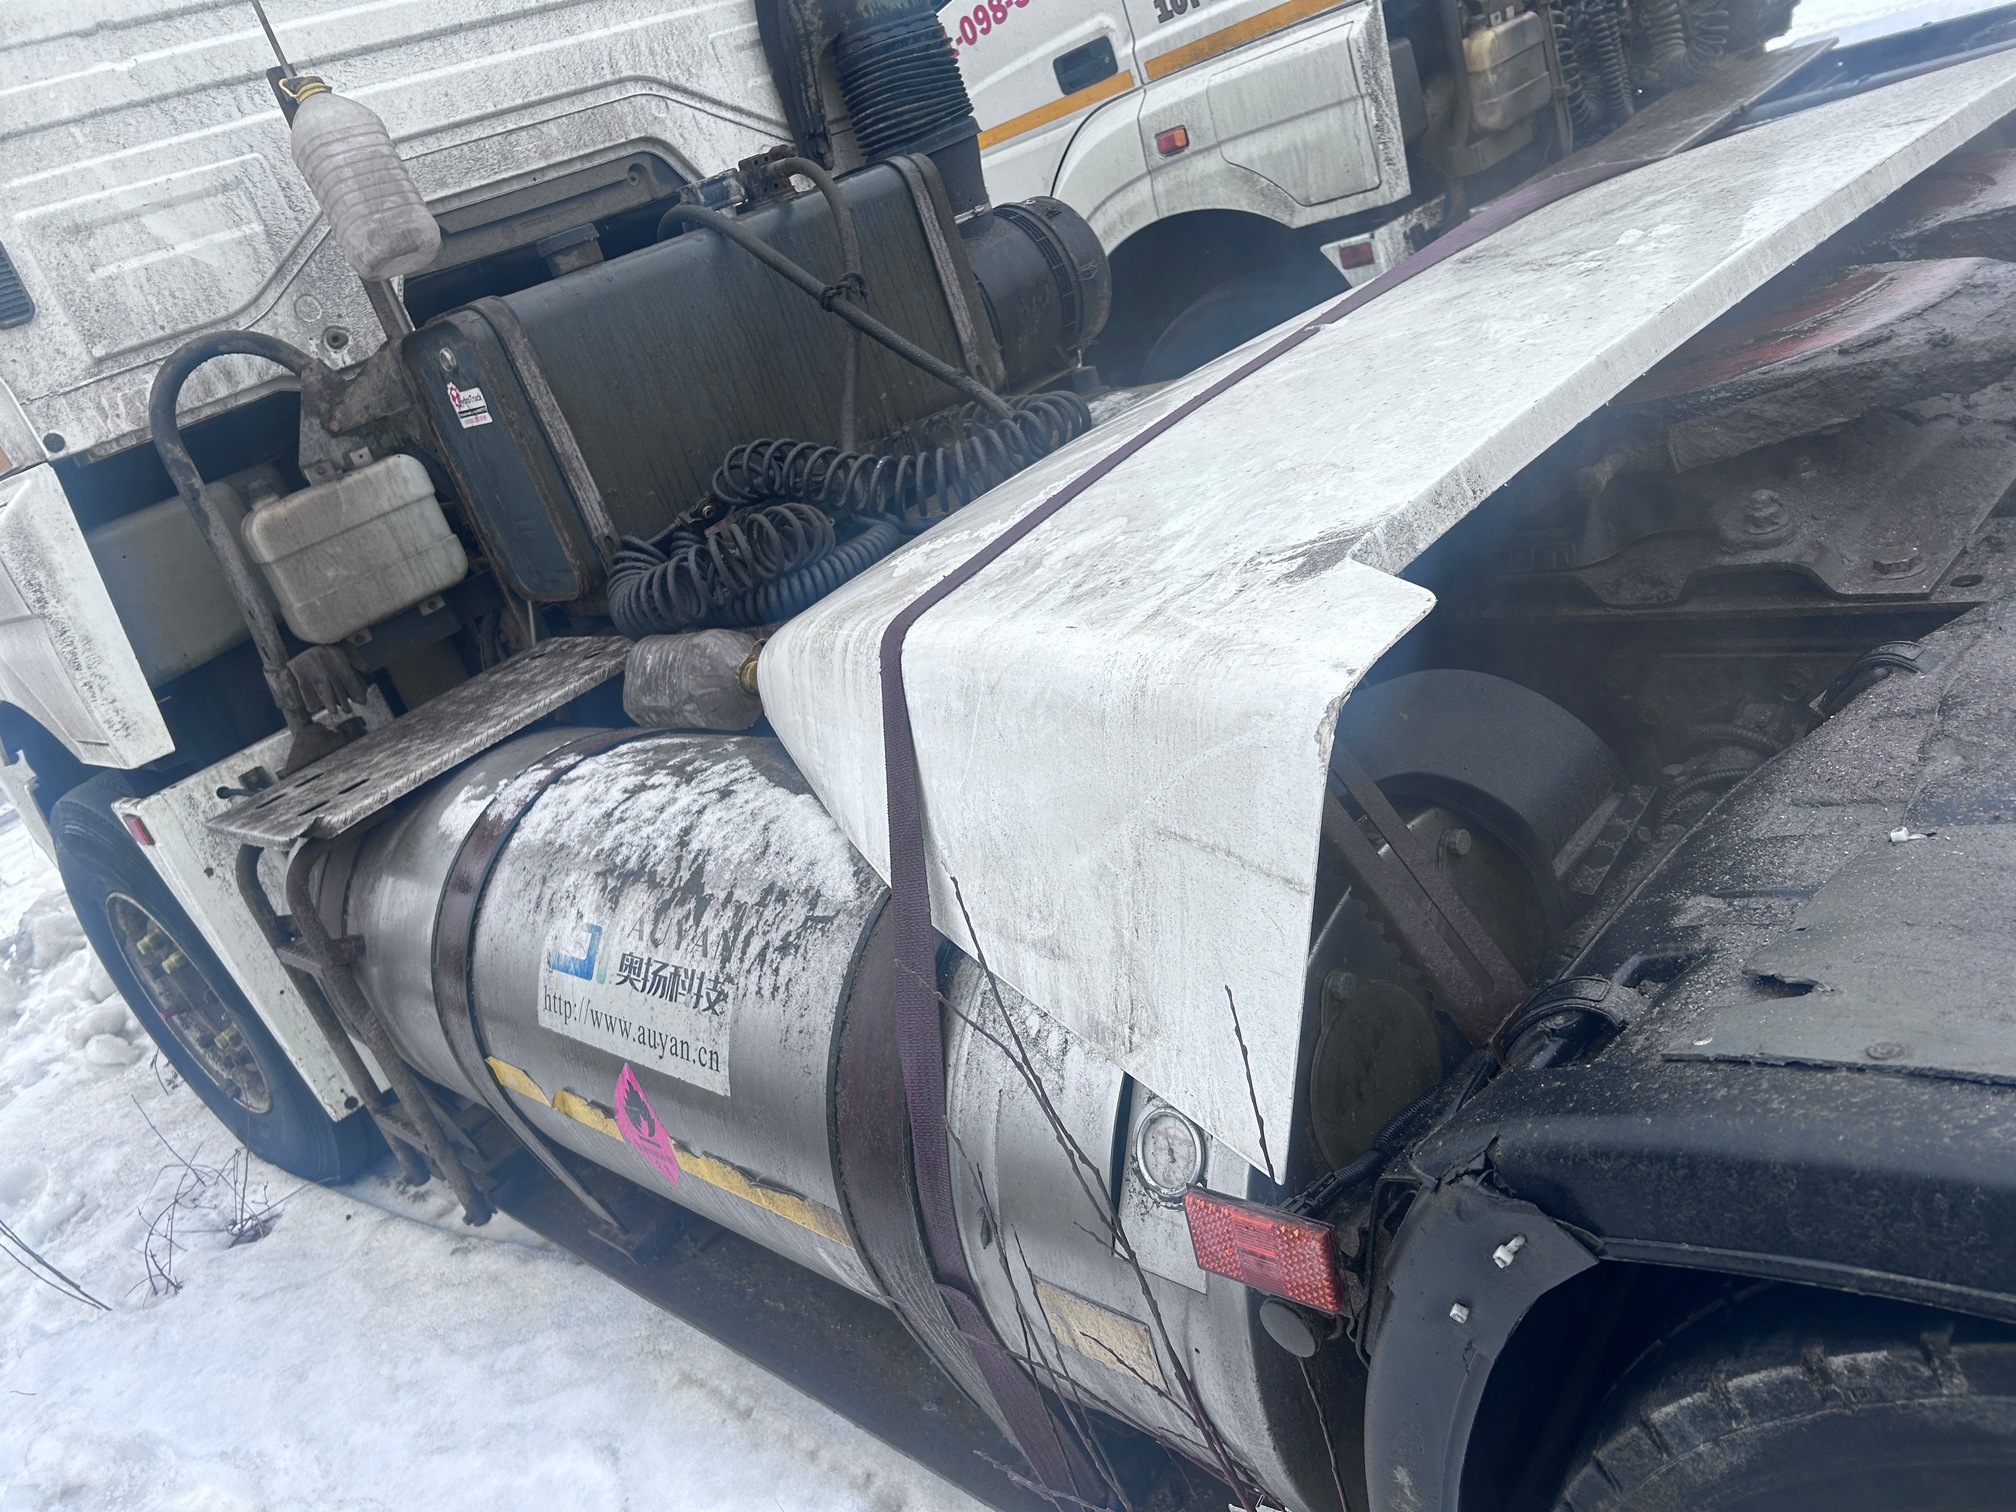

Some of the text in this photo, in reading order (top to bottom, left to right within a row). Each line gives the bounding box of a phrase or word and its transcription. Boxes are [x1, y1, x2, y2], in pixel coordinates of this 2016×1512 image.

[616, 951, 730, 1016] 奥扬科技
[543, 985, 721, 1073] http://www.auyan.cn
